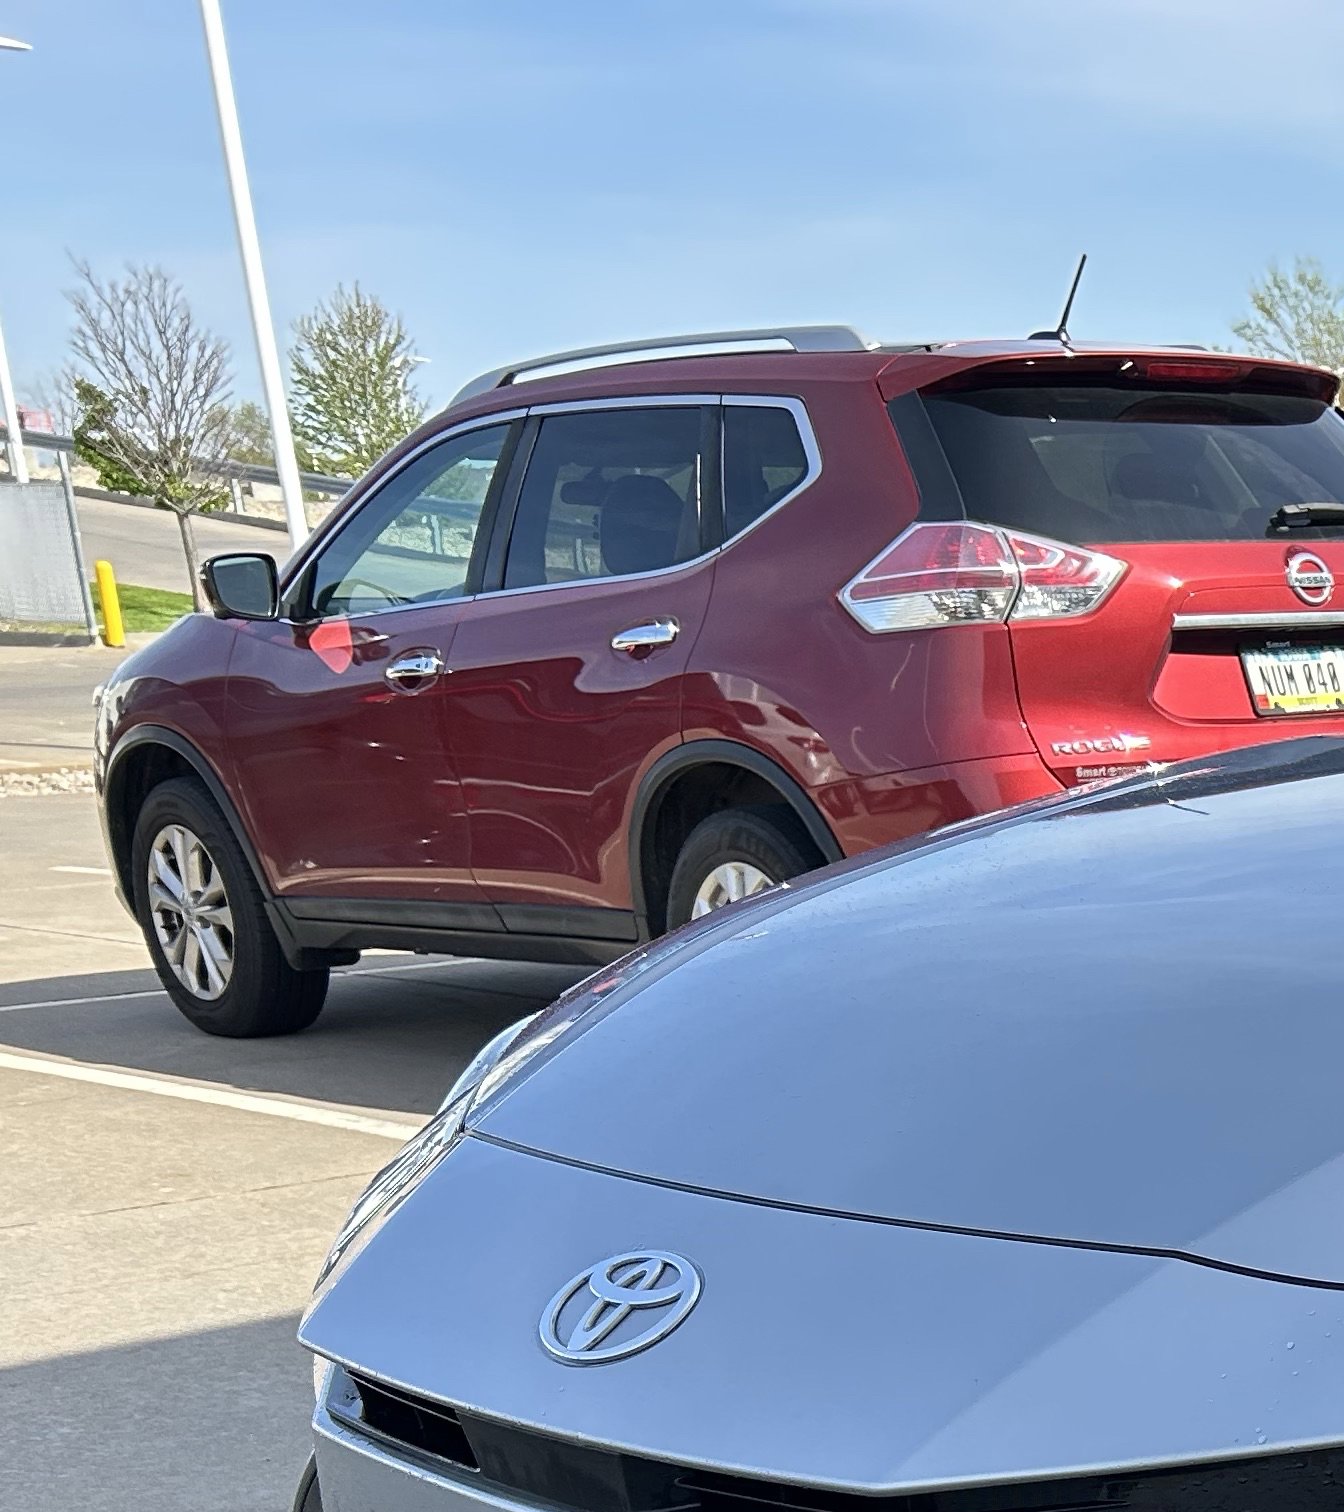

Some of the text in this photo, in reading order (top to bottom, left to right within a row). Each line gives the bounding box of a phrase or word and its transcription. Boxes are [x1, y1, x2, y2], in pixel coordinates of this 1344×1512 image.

[1294, 575, 1331, 584] NISSAN
[1258, 662, 1340, 696] NUM 040
[1076, 766, 1107, 778] Smart
